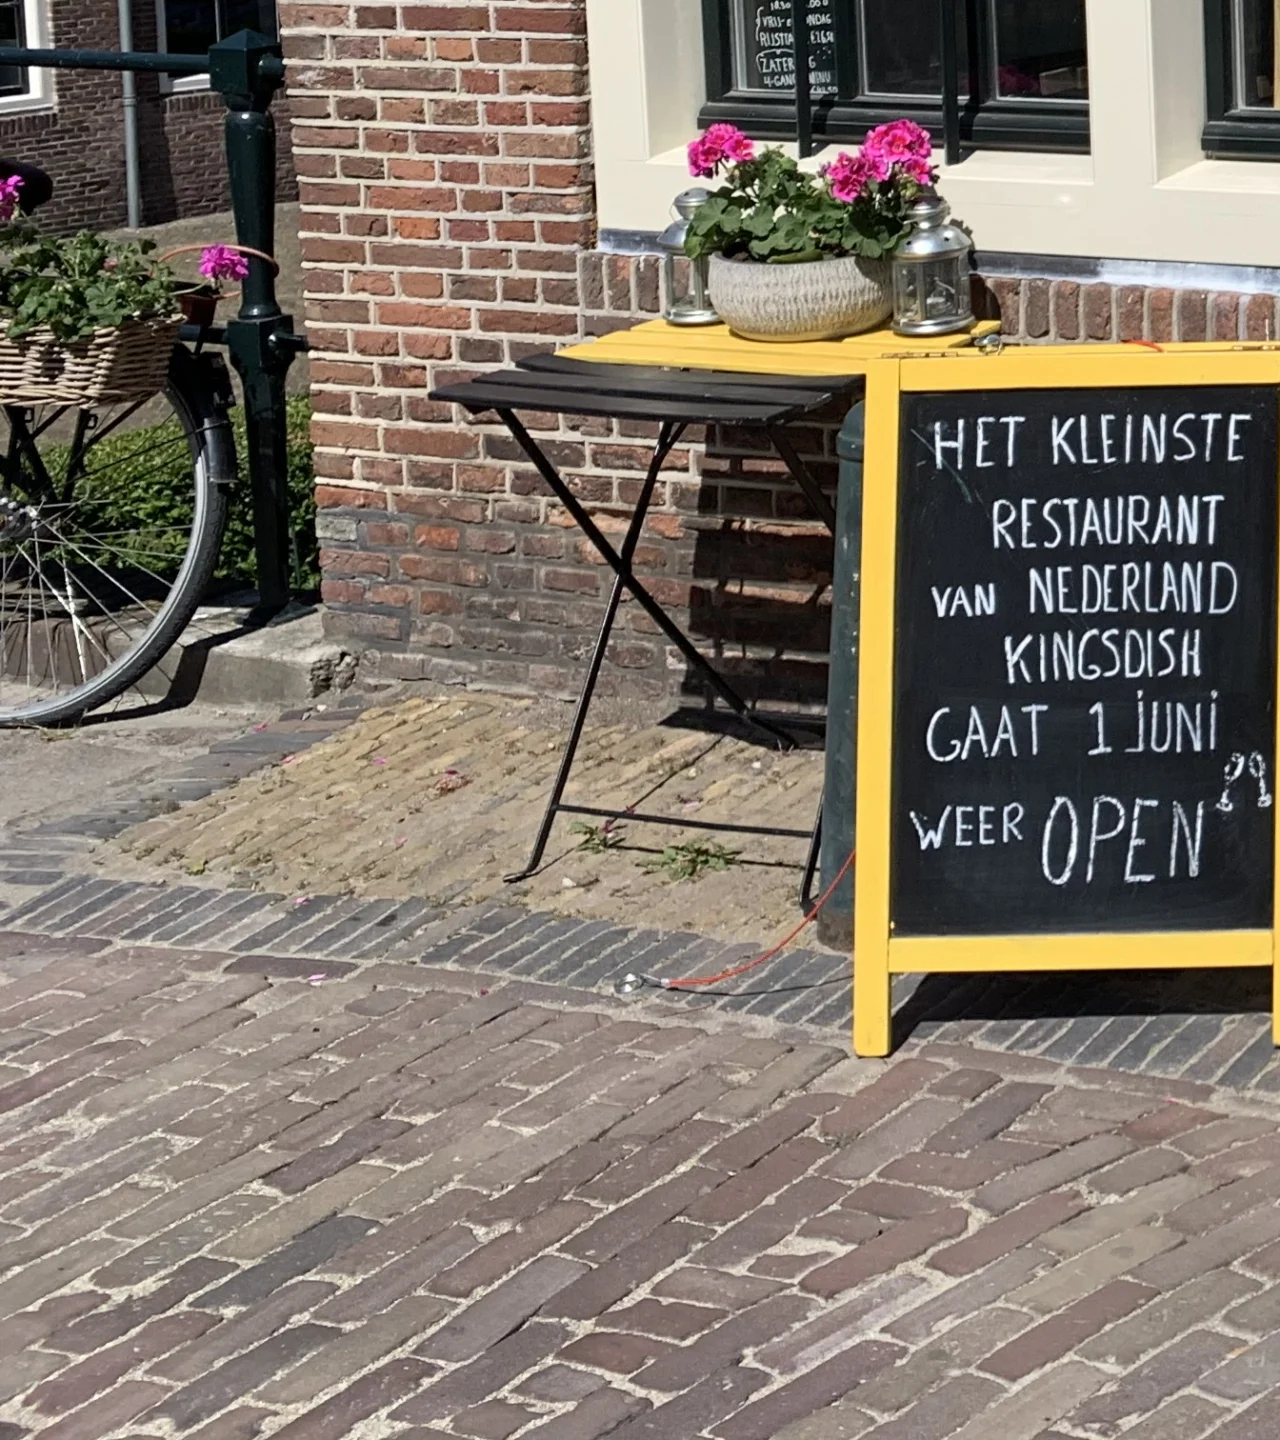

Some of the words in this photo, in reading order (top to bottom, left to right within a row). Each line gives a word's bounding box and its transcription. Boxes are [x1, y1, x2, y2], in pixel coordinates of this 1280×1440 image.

[933, 415, 1026, 471] HET
[1051, 412, 1253, 466] KLEINSTE
[992, 494, 1226, 550] RESTAURANT
[930, 582, 997, 618] VAN
[1029, 560, 1239, 616] NEDERLAND
[1004, 627, 1202, 685] KINGSDISH
[926, 703, 1049, 762] GAAT
[1087, 701, 1114, 757] 1
[909, 802, 1025, 851] WEER
[1041, 794, 1204, 886] OPEN
